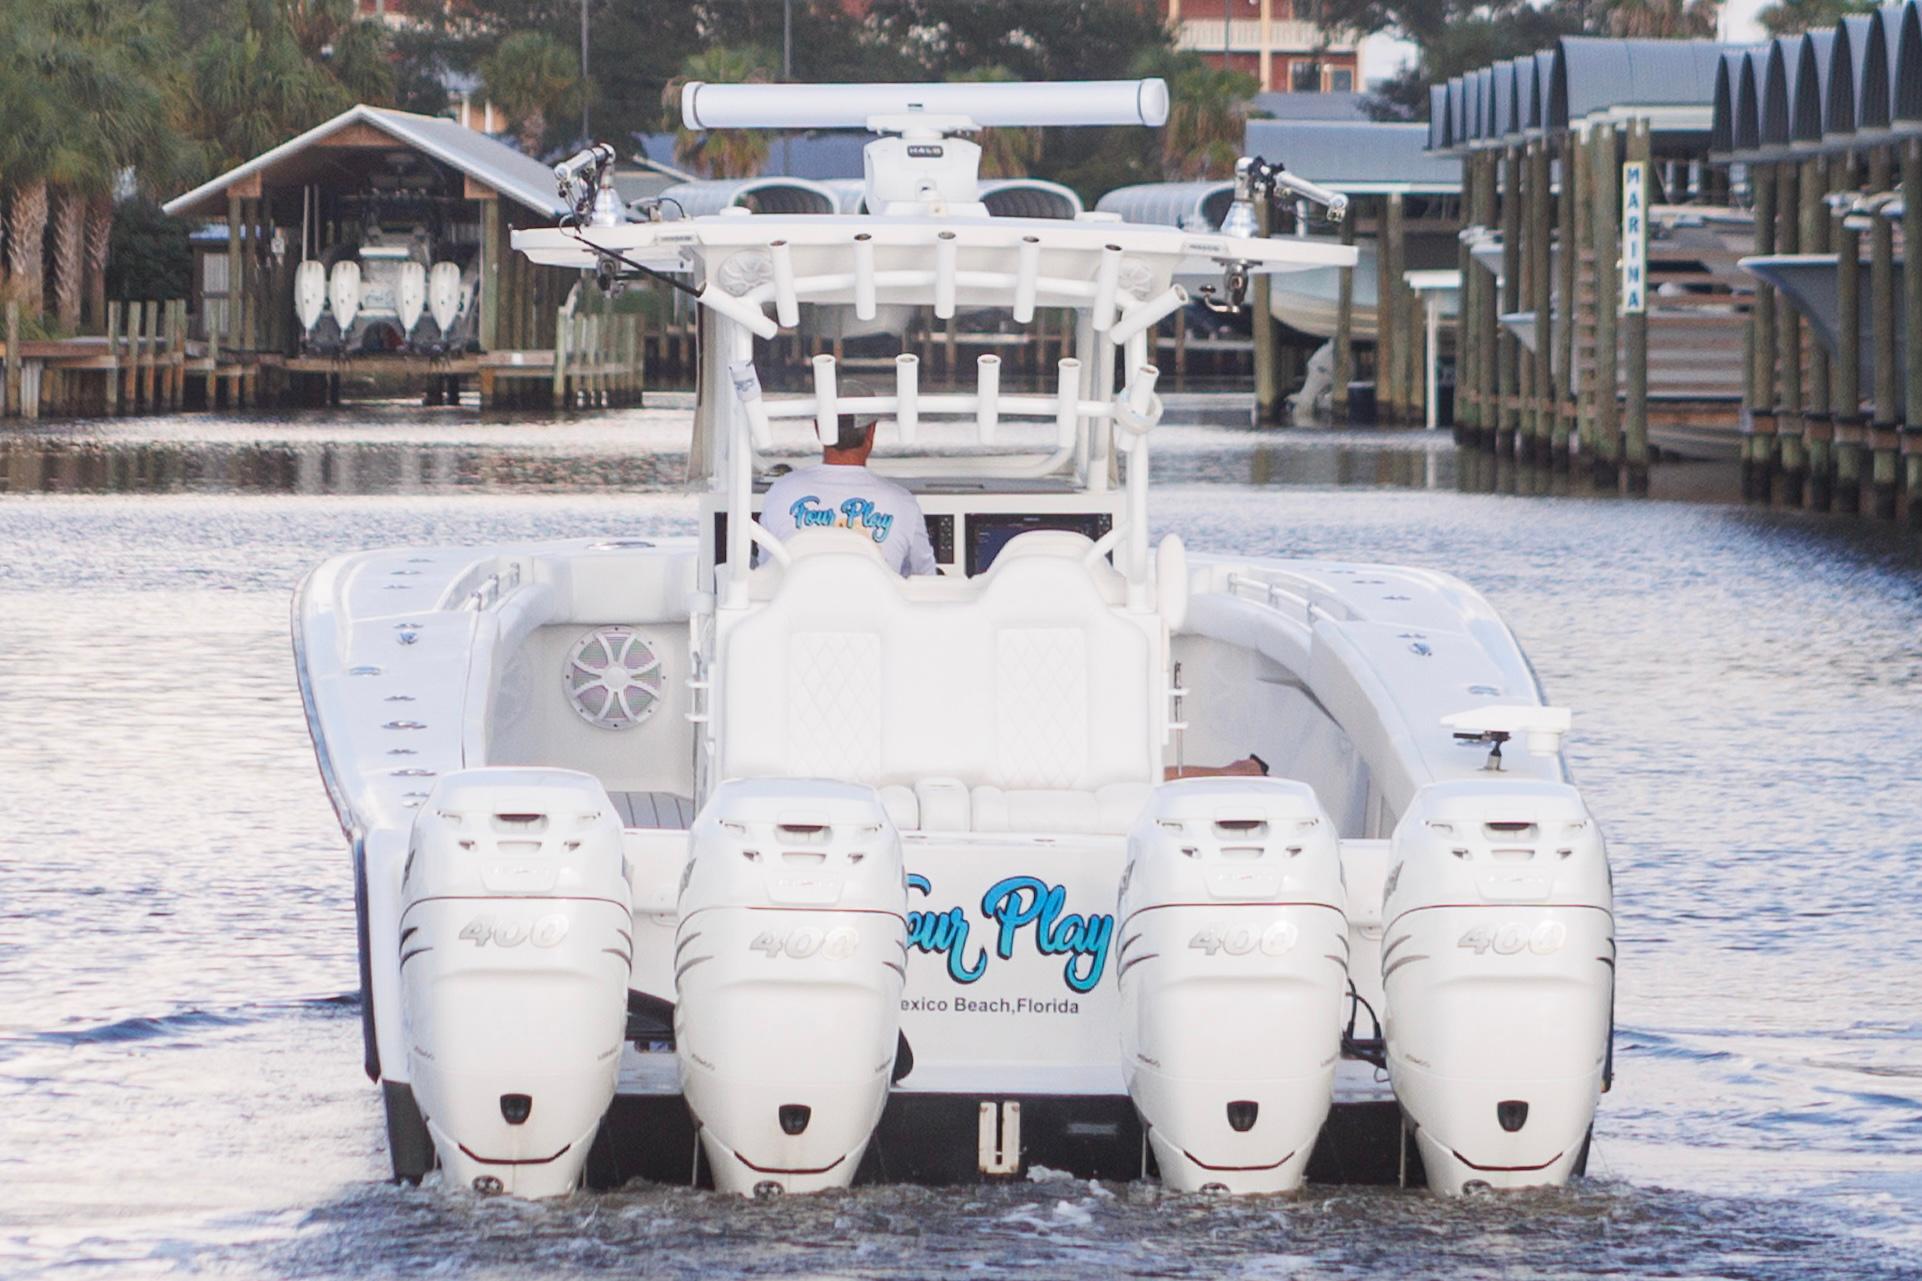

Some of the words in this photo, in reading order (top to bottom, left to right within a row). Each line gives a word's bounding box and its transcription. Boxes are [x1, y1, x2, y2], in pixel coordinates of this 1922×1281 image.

[1627, 167, 1640, 308] MARINA
[789, 495, 836, 529] Four
[840, 497, 894, 543] Play
[458, 913, 570, 948] 400
[748, 926, 860, 960] 400
[906, 873, 988, 984] our
[981, 875, 1114, 994] Play
[1187, 920, 1299, 957] 400
[1457, 920, 1567, 956] 400
[900, 997, 948, 1012] exico
